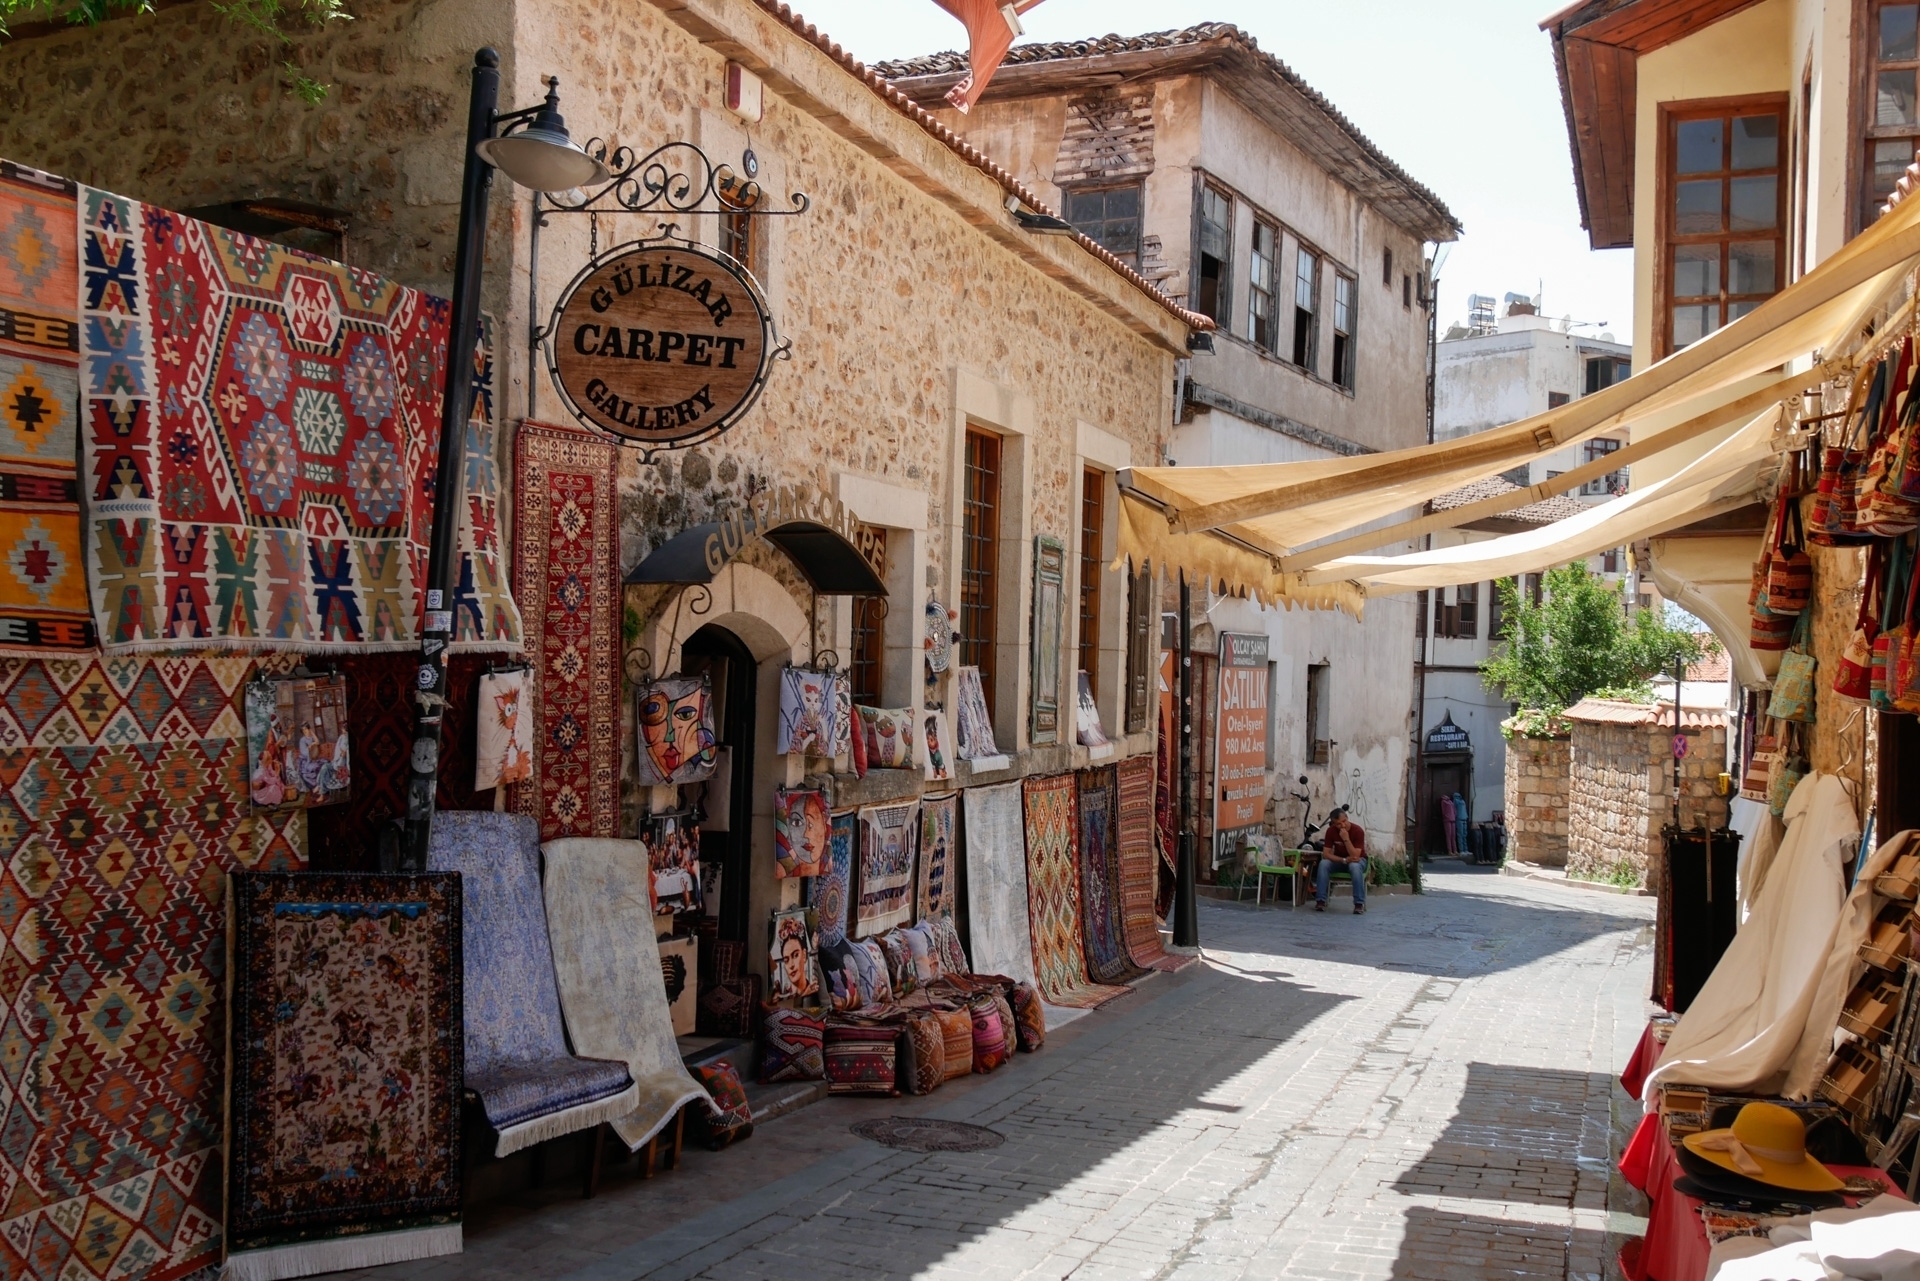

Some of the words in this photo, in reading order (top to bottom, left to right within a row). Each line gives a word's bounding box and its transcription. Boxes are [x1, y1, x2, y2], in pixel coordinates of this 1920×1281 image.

[590, 255, 733, 328] GÜLİZAR
[573, 323, 745, 370] CARPET
[585, 378, 716, 431] GALLERY
[819, 490, 895, 585] CARPET
[1232, 639, 1250, 655] OLCAY
[1223, 669, 1267, 711] SATILIK
[1225, 738, 1239, 755] 980
[1240, 737, 1251, 753] M2
[1430, 733, 1466, 742] RESTAURANT
[1221, 764, 1229, 780] 30
[1244, 783, 1249, 798] 4
